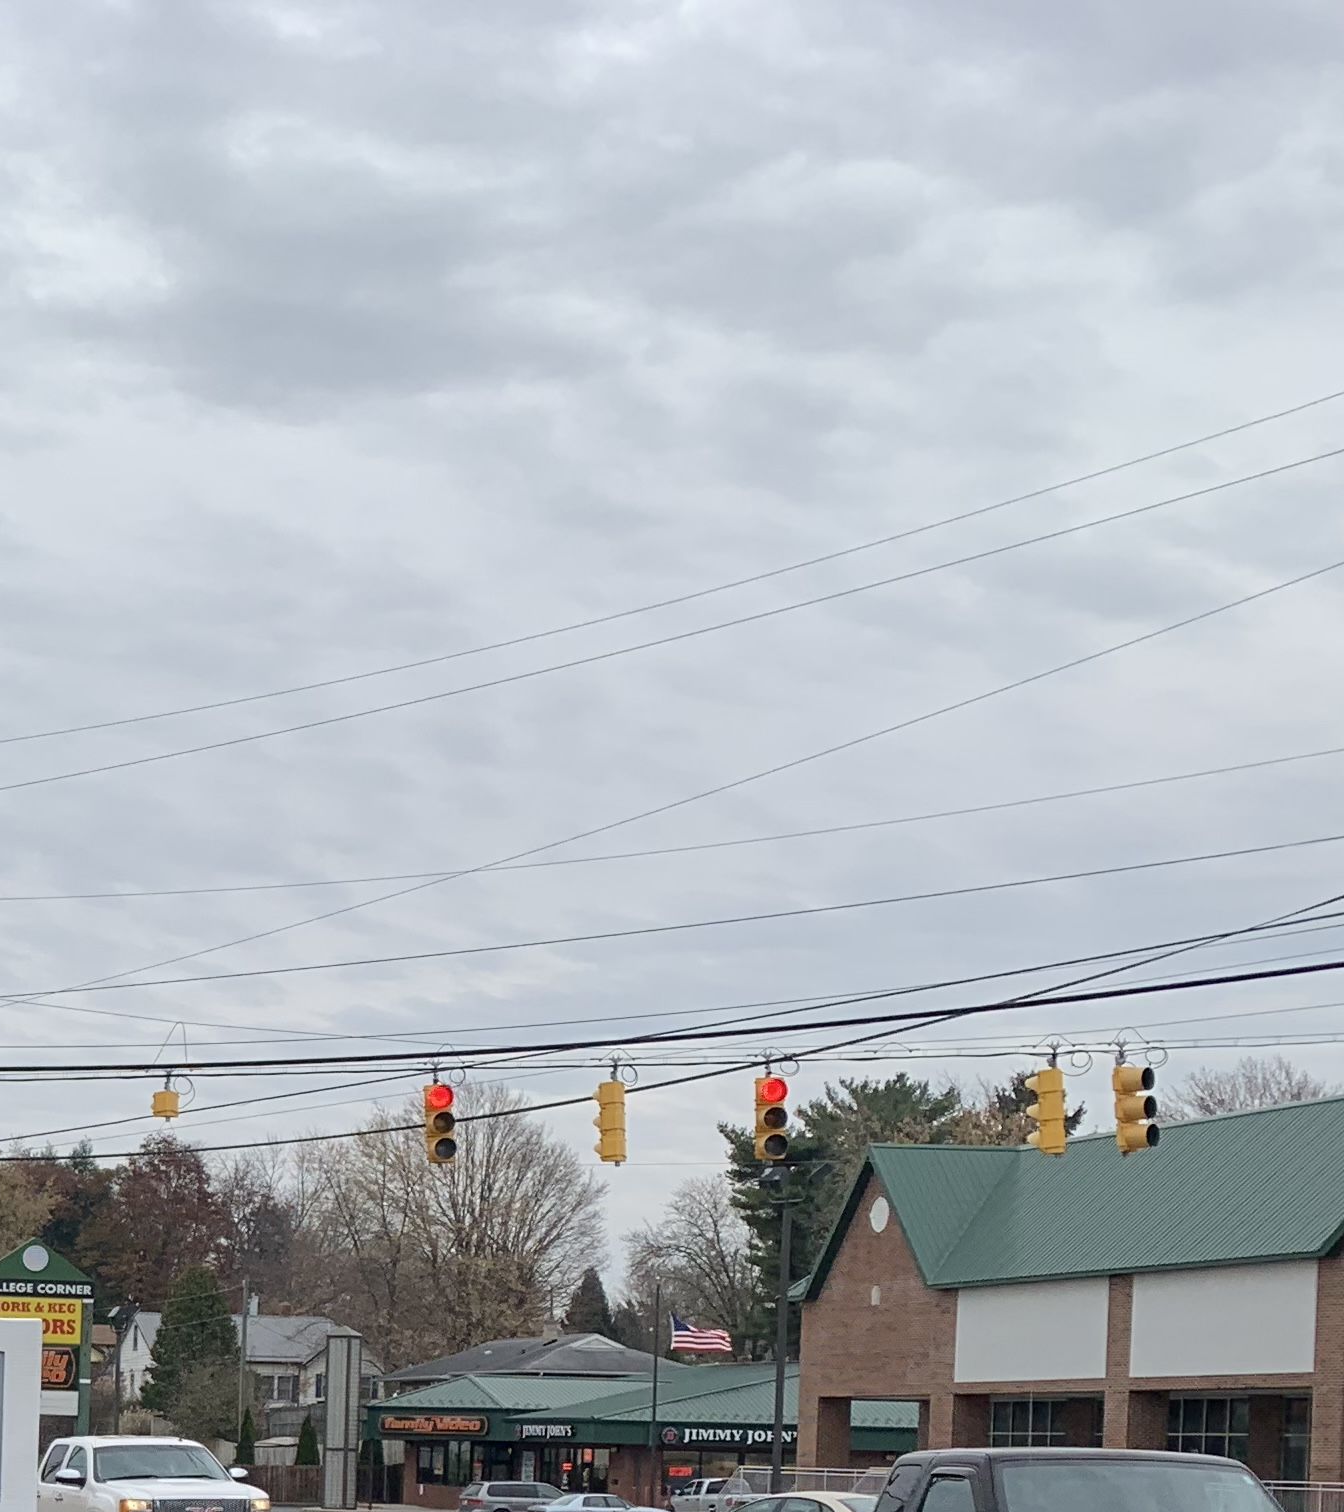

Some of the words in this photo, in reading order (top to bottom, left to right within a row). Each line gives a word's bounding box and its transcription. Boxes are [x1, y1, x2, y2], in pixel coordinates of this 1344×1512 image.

[37, 1284, 92, 1295] CORNER
[34, 1303, 45, 1313] &
[48, 1303, 76, 1314] KEG
[523, 1425, 546, 1438] JIMMY
[683, 1428, 743, 1443] JIMMY
